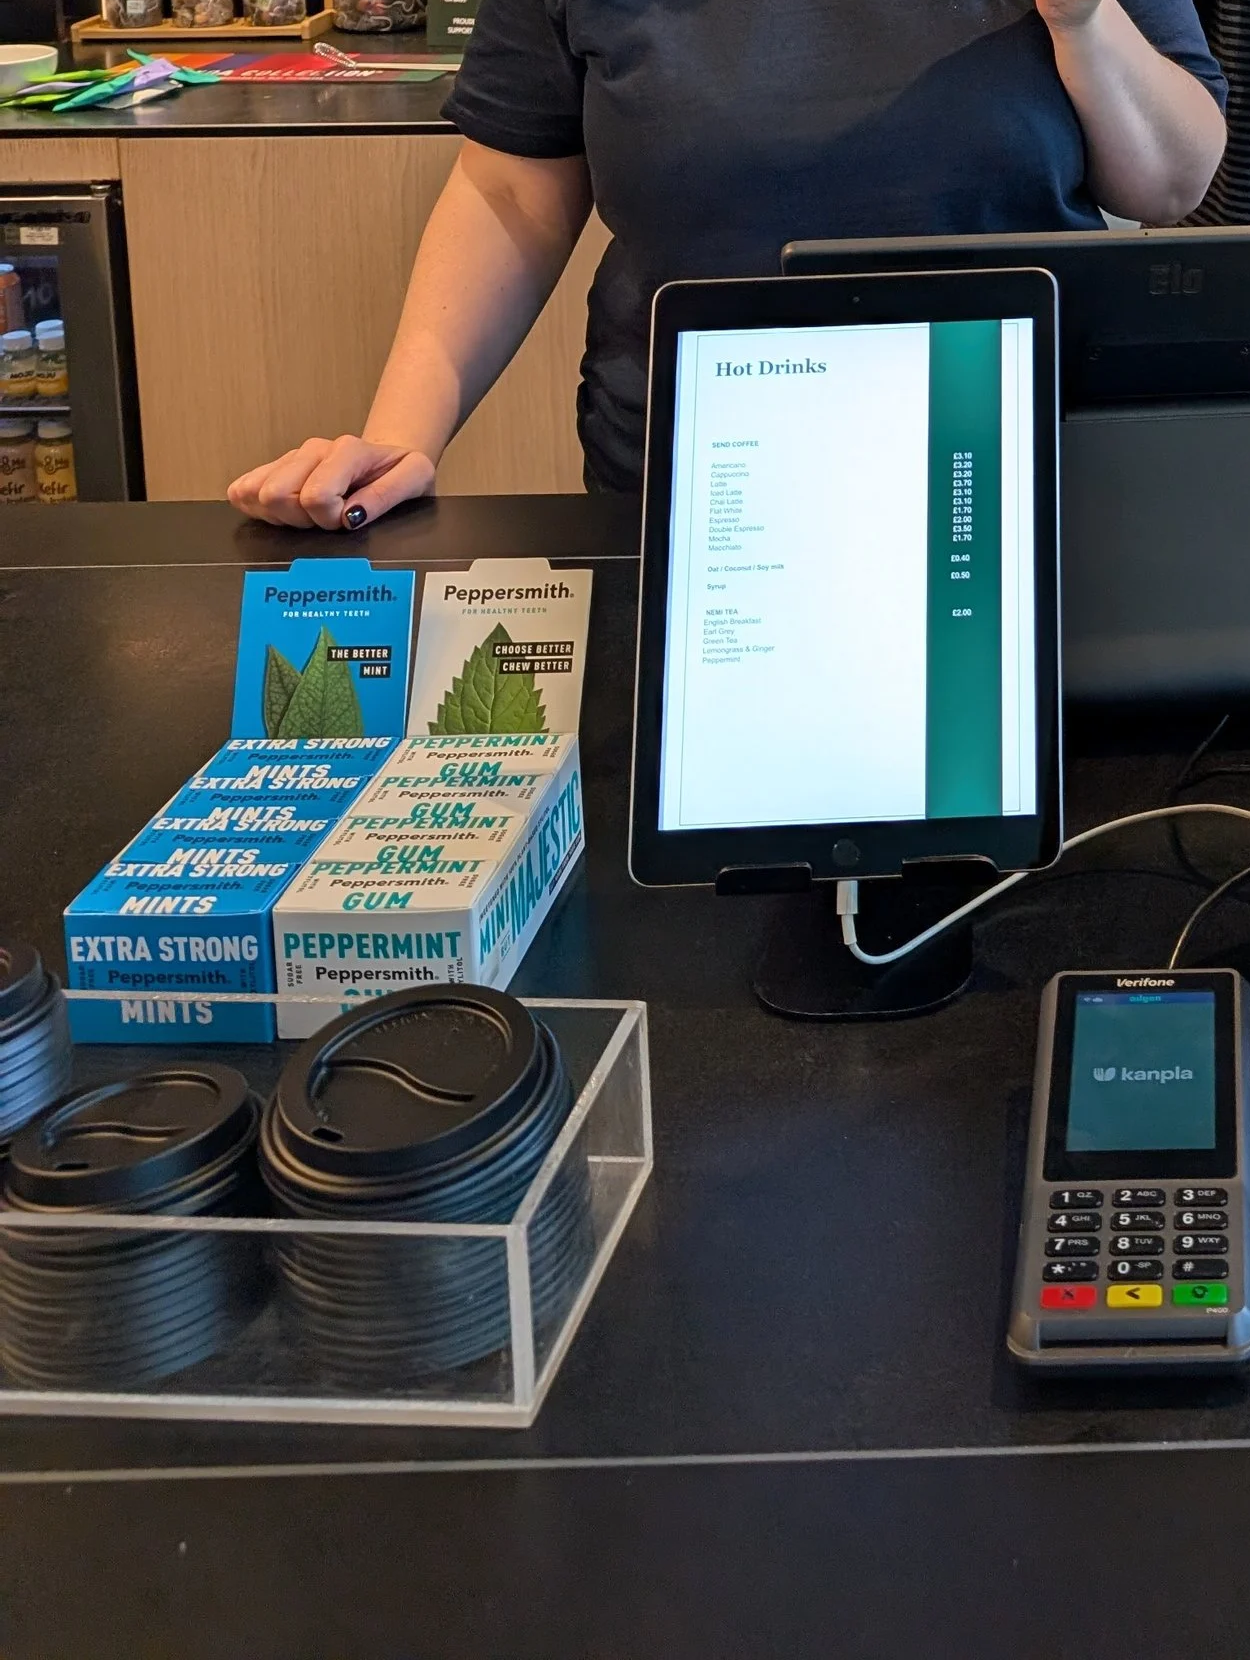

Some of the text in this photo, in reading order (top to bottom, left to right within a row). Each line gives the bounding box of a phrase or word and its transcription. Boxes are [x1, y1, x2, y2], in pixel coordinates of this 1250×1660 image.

[715, 358, 827, 377] Hot Drinks
[732, 440, 759, 448] COFFEE
[953, 452, 972, 460] £3.10
[953, 461, 972, 469] £3.20
[953, 479, 972, 487] £3.70
[734, 525, 765, 533] Espresso
[282, 609, 370, 618] FOR HEALTHY TEETH
[462, 606, 548, 616] FOR HEALTHY TEETH
[331, 648, 389, 659] THE BETTER
[495, 643, 572, 656] CHOOSE BETTER
[363, 666, 388, 676] MINT
[502, 660, 570, 672] CHEW BETTER
[509, 770, 581, 944] MAJESTIC
[104, 863, 289, 878] EXTRA STRONG
[312, 860, 486, 877] PEPPERMINT
[119, 895, 217, 915] MINTS
[341, 891, 414, 912] GUM
[479, 887, 510, 966] MINI
[70, 935, 259, 962] EXTRA STRONG
[283, 931, 462, 959] PEPPERMINT
[1116, 977, 1175, 988] Verifone
[120, 1000, 214, 1025] MINTS
[1121, 1067, 1194, 1084] kanpla
[1120, 1190, 1132, 1202] 2
